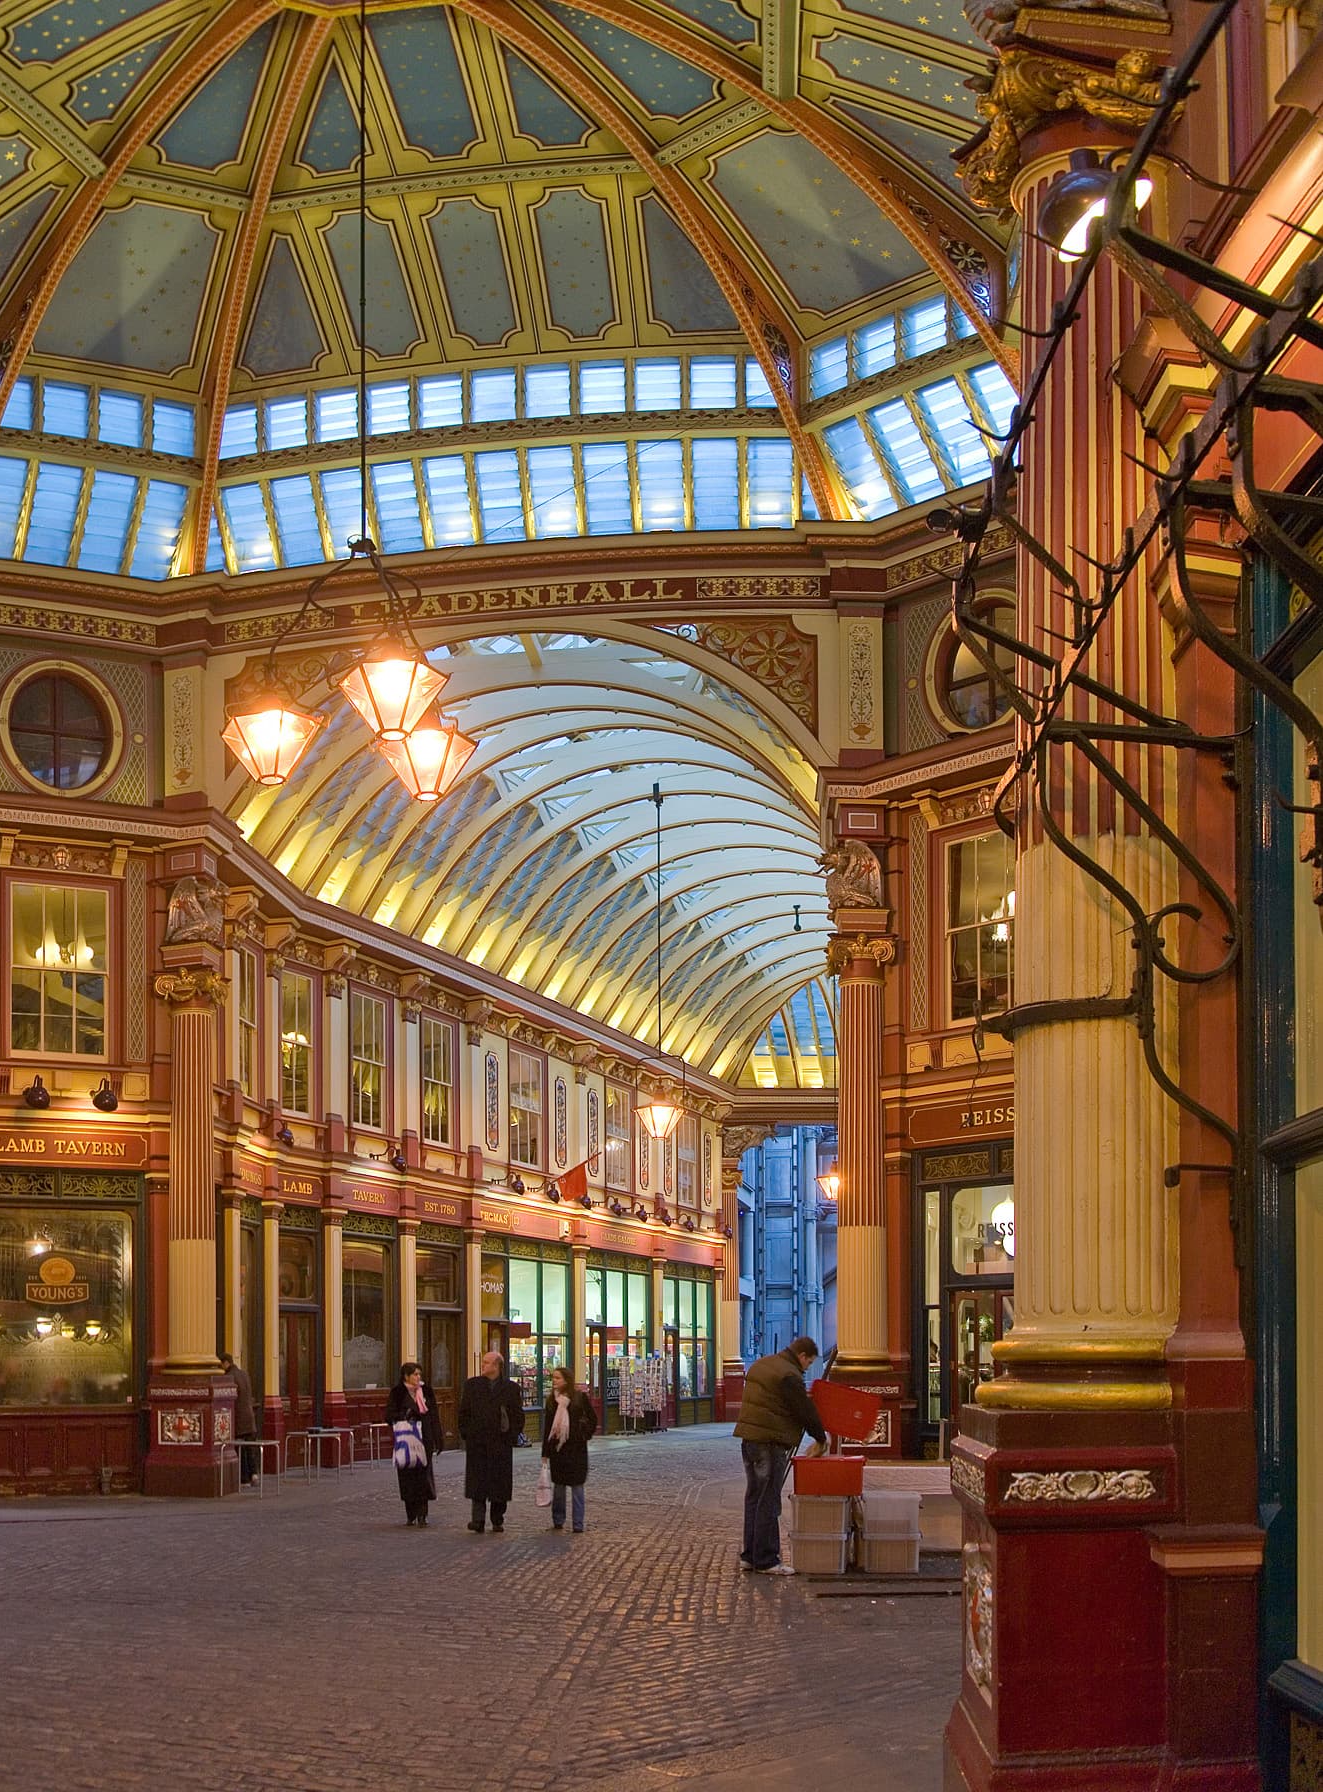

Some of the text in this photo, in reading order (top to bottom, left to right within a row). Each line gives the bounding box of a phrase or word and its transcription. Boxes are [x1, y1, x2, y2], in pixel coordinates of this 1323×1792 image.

[349, 579, 682, 625] LEADENHALL
[961, 1106, 1014, 1128] REISS
[54, 1139, 126, 1156] TAVERN
[283, 1180, 313, 1195] LAMB
[352, 1189, 386, 1204] TAVERN
[31, 1287, 84, 1299] YOUNG'S
[480, 1281, 504, 1294] HOMAS'
